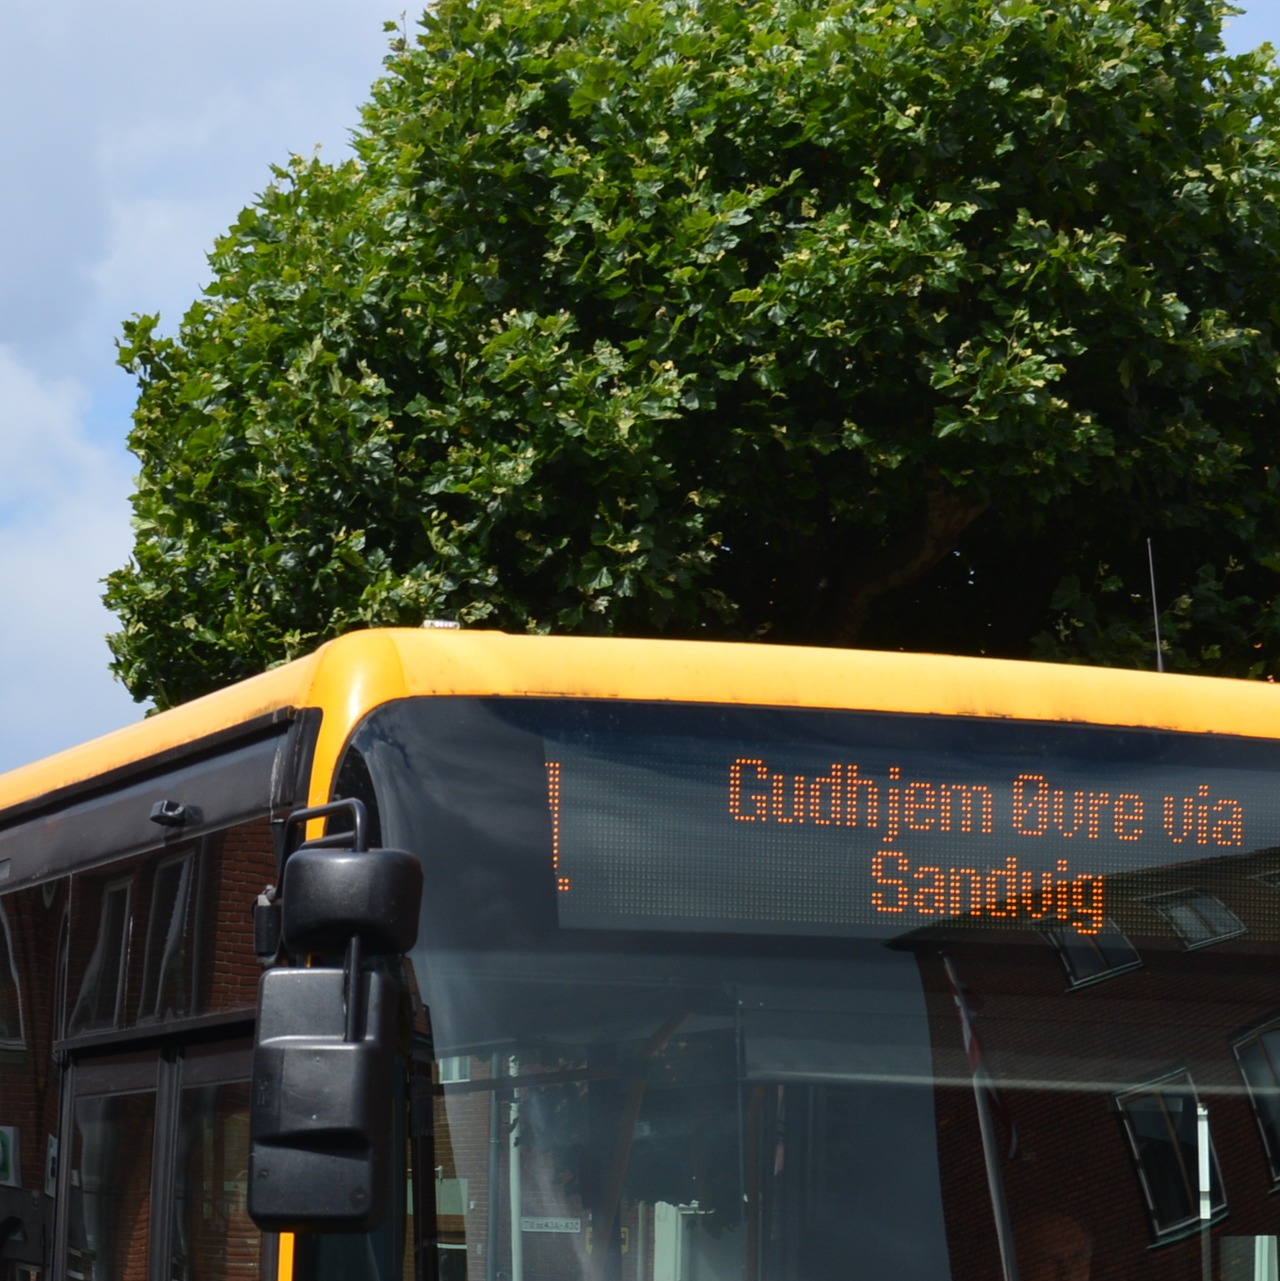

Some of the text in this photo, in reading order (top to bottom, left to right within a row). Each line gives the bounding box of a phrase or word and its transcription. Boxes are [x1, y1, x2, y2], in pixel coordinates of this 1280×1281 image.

[727, 757, 1244, 847] Gudhjem Øvre via
[870, 849, 1104, 936] Sandvig
